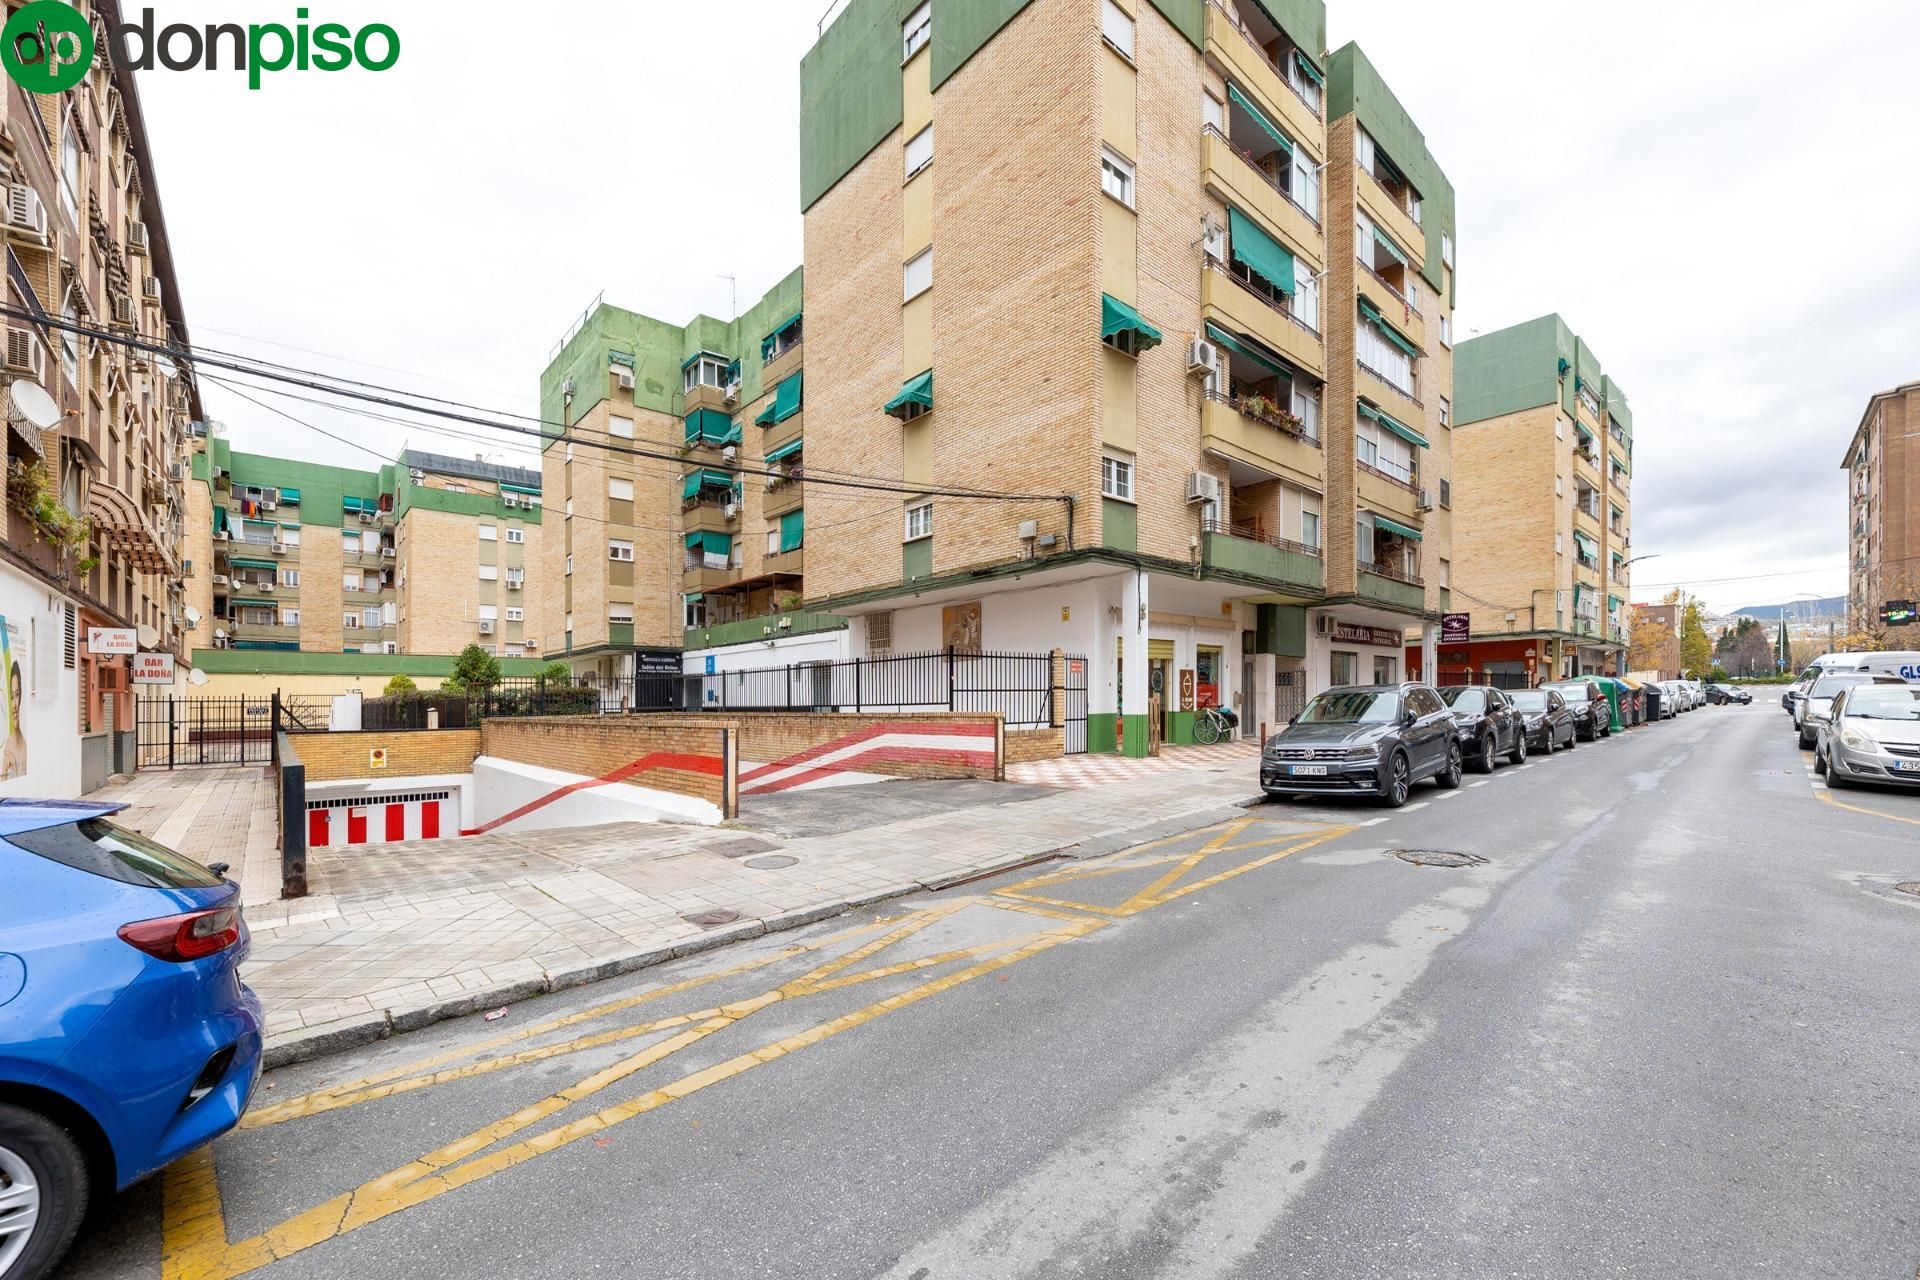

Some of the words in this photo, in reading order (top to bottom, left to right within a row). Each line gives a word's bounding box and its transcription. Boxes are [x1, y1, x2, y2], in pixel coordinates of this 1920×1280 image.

[1443, 614, 1468, 622] ESTELARIA
[1336, 626, 1371, 641] ESTELARIA
[144, 658, 163, 666] BAR
[134, 669, 145, 677] LA
[147, 668, 172, 678] DOÑA
[1293, 766, 1310, 774] 5071
